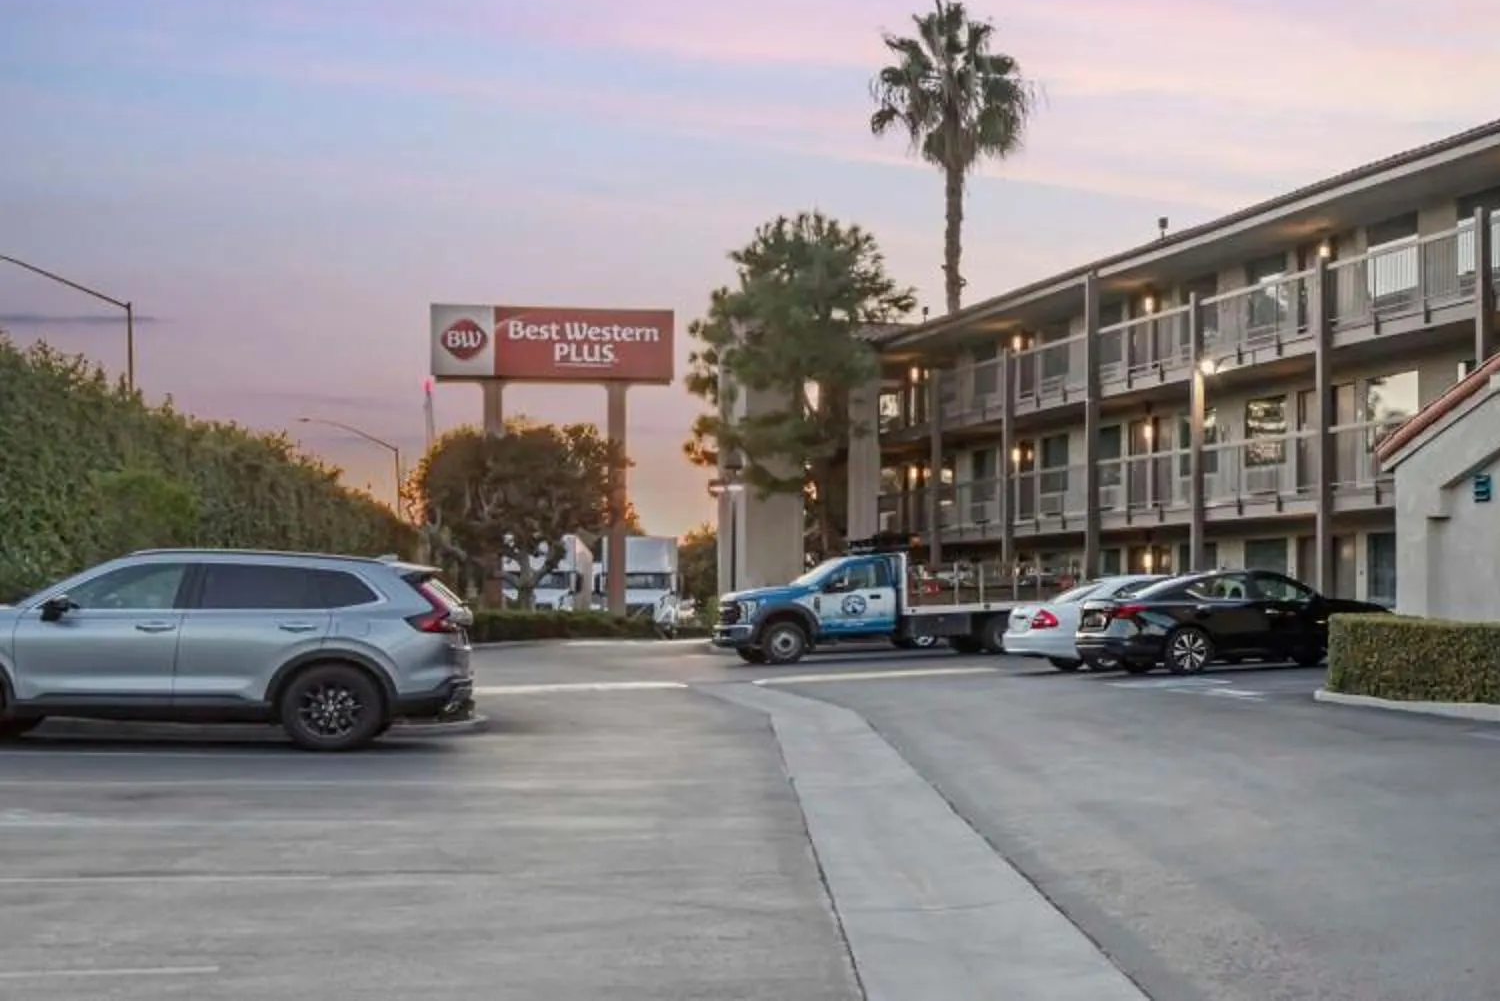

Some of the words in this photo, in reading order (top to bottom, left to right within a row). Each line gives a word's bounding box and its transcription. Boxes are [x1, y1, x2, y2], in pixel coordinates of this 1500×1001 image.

[446, 329, 482, 349] BW
[508, 320, 560, 340] Best
[564, 322, 660, 342] Western
[554, 343, 615, 363] PLUS
